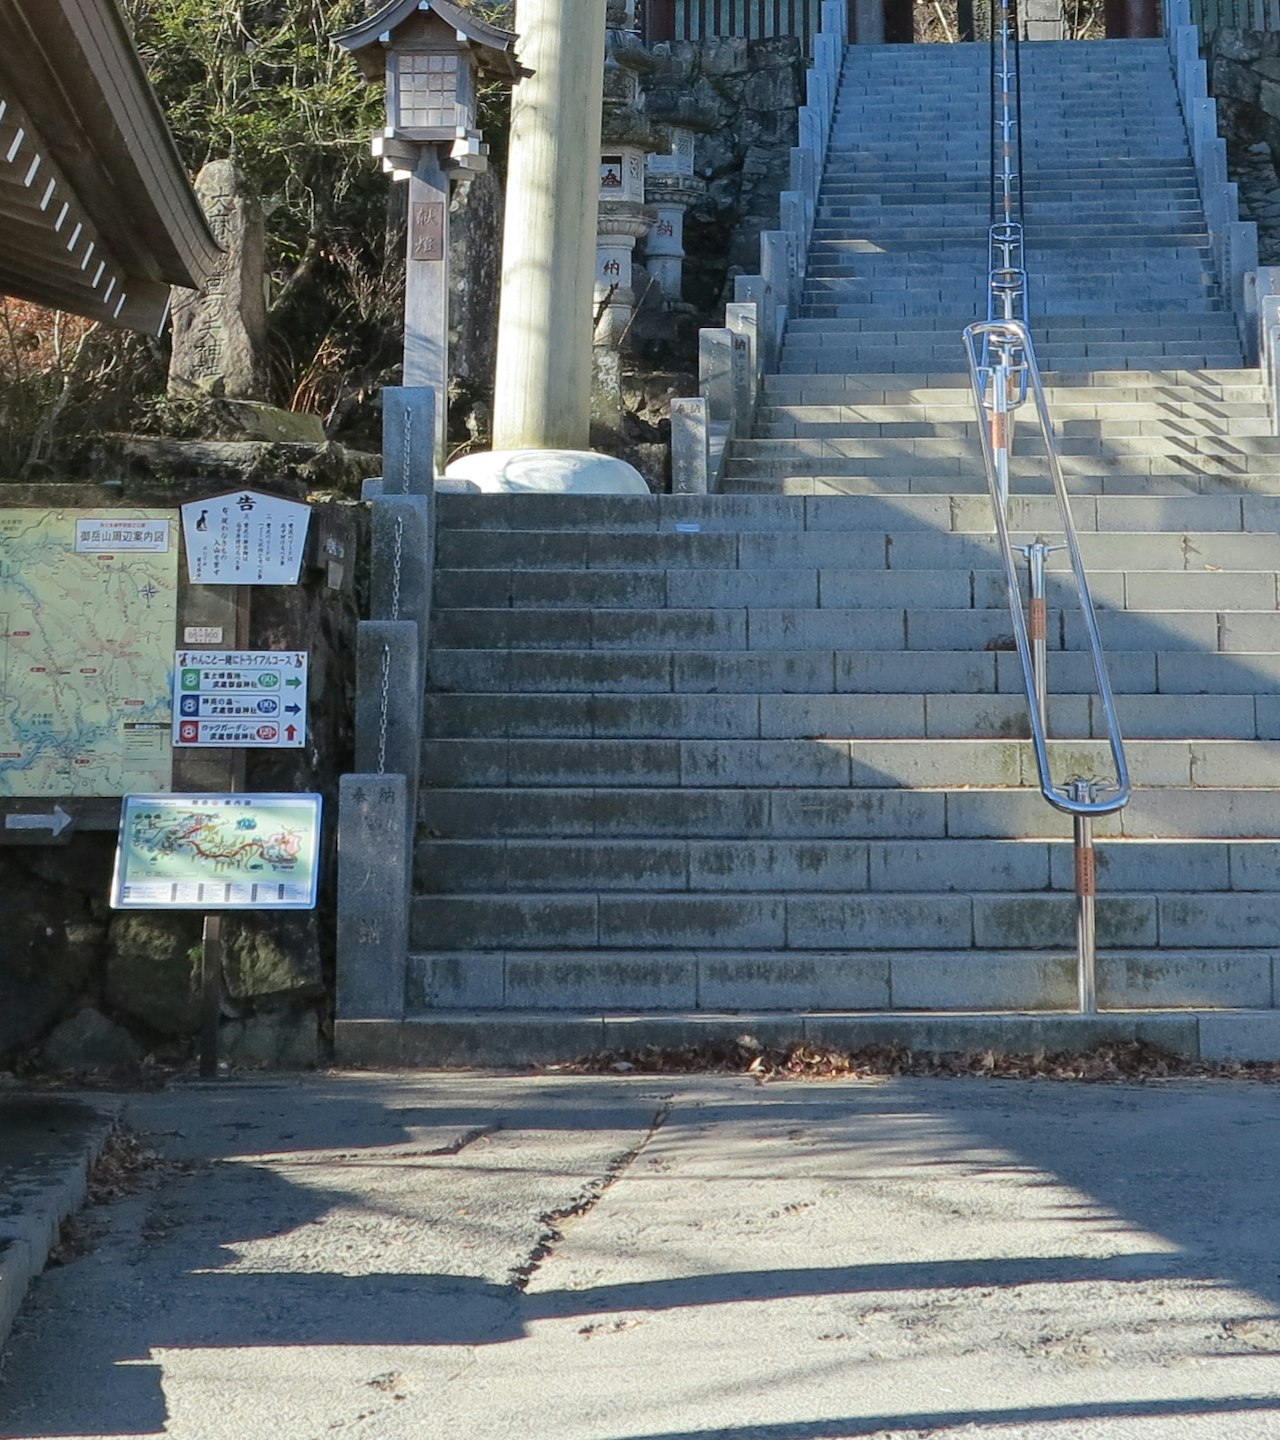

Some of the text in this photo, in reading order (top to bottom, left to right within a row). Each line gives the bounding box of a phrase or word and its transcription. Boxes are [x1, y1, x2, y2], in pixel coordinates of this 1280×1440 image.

[236, 494, 257, 512] 告
[80, 530, 165, 543] 御岳山周辺案内図
[191, 655, 293, 666] わんこと一緒にトライアルコース
